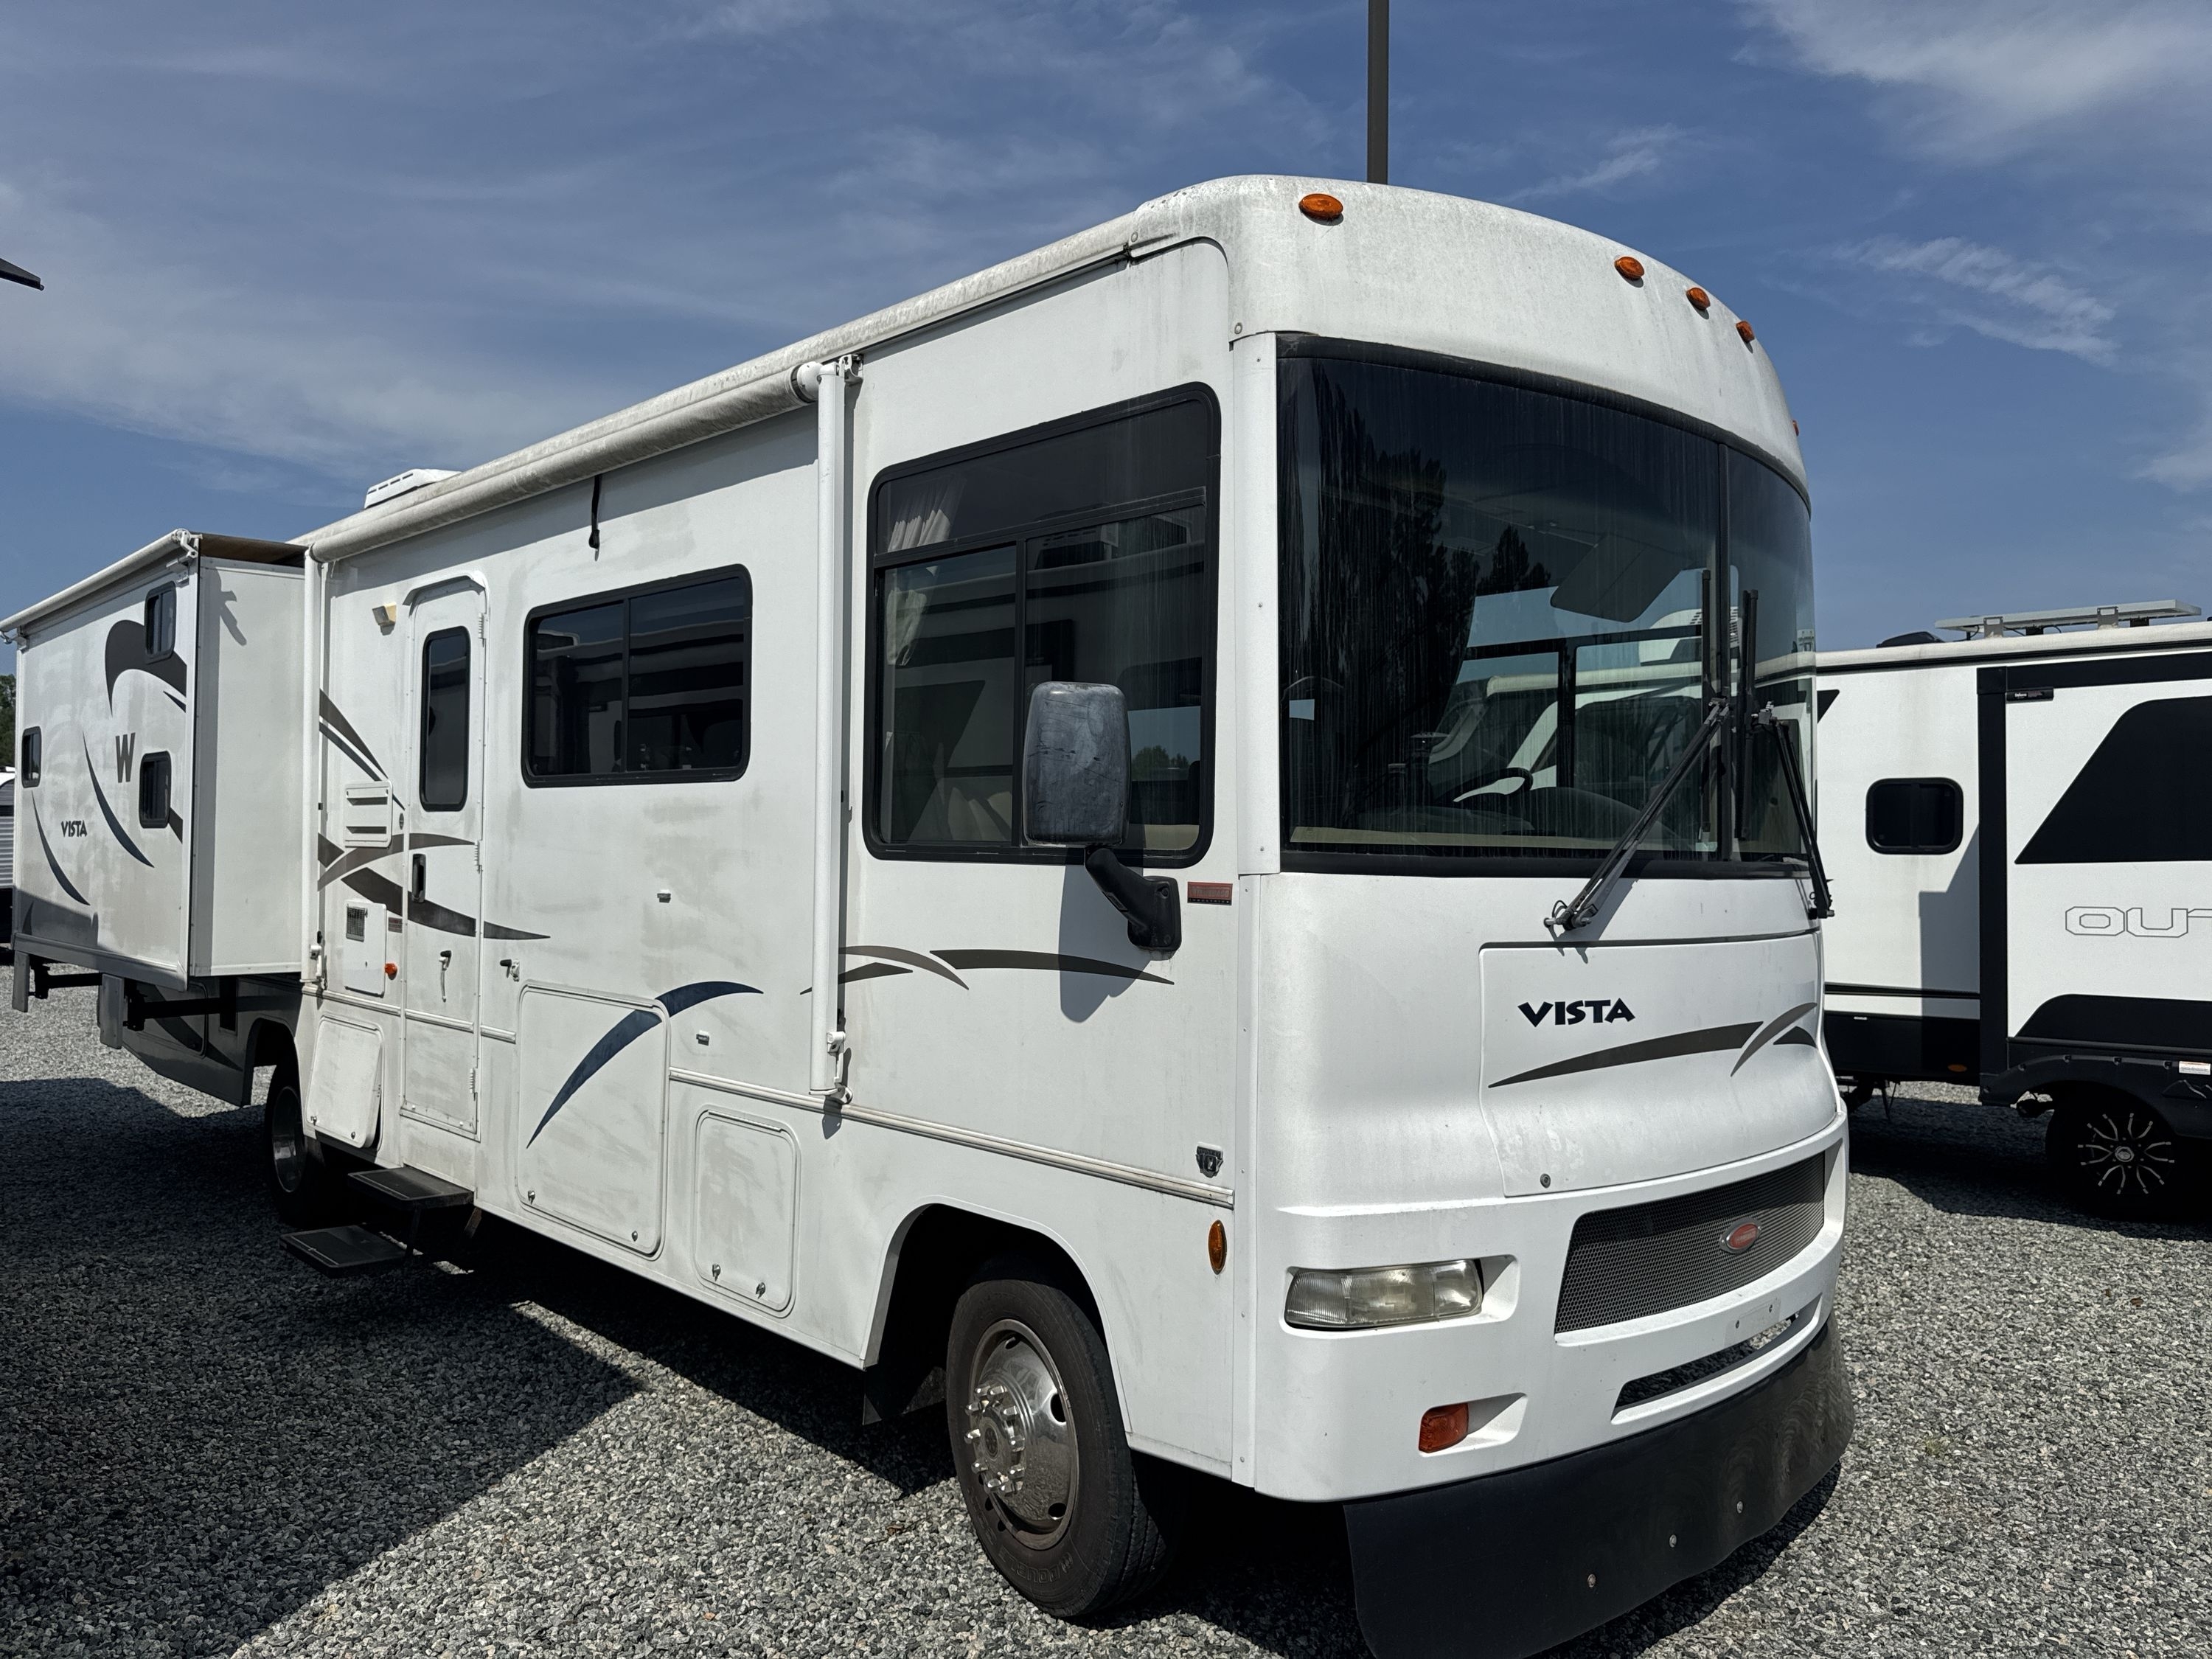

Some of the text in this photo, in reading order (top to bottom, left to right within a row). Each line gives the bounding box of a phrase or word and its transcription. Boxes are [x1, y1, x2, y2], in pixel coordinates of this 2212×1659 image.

[115, 732, 136, 783] W
[60, 819, 88, 838] VISTA
[1517, 998, 1635, 1028] VISTA
